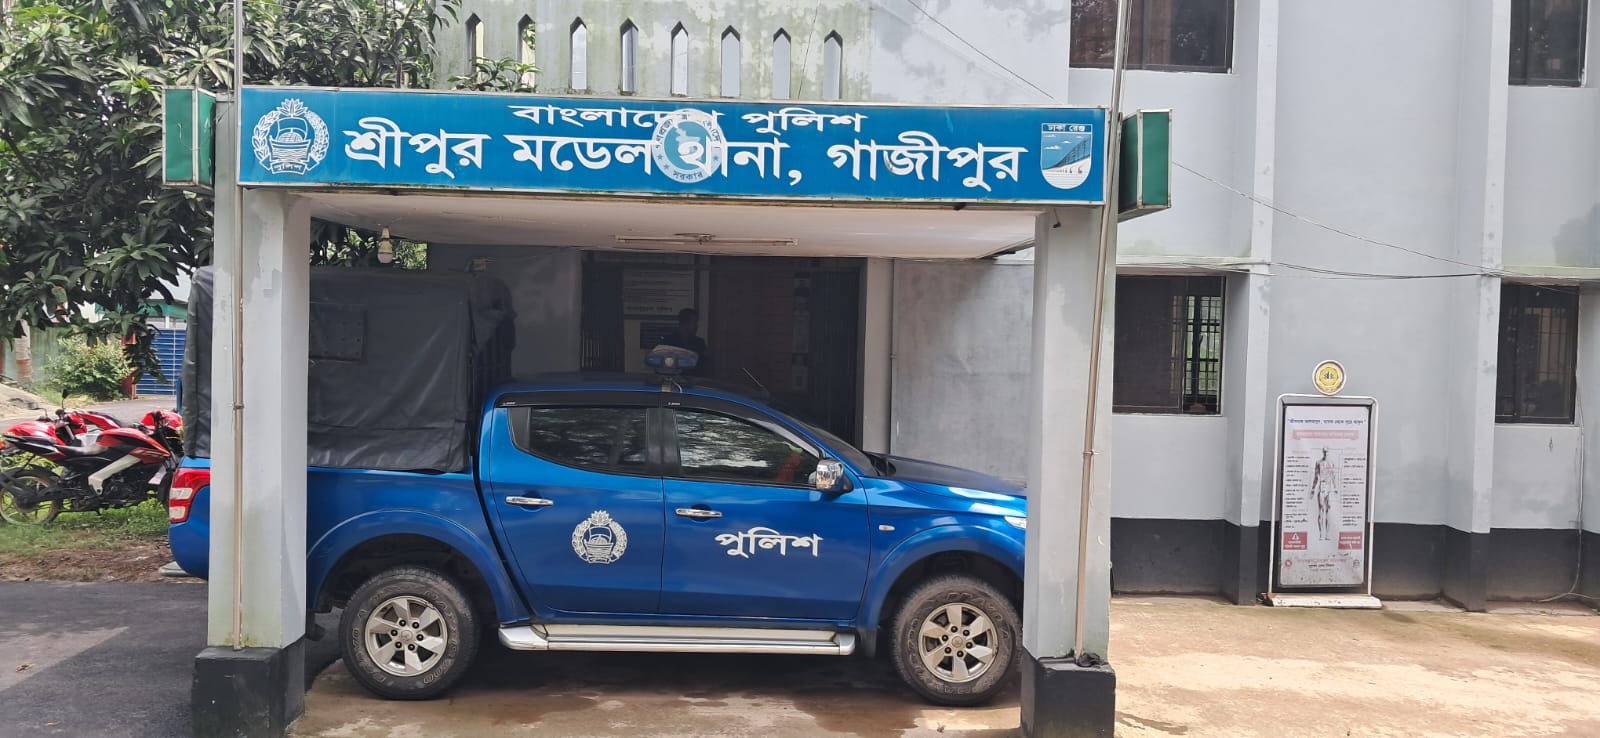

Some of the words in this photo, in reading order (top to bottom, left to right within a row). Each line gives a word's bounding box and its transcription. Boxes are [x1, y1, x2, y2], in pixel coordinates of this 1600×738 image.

[741, 107, 869, 136] পুলিশ
[342, 116, 492, 180] শ্রীপুর
[503, 134, 653, 176] মডেল
[677, 136, 803, 187] থানা,
[827, 130, 1029, 192] গাজীপুর
[715, 526, 824, 559] পুলিশ
